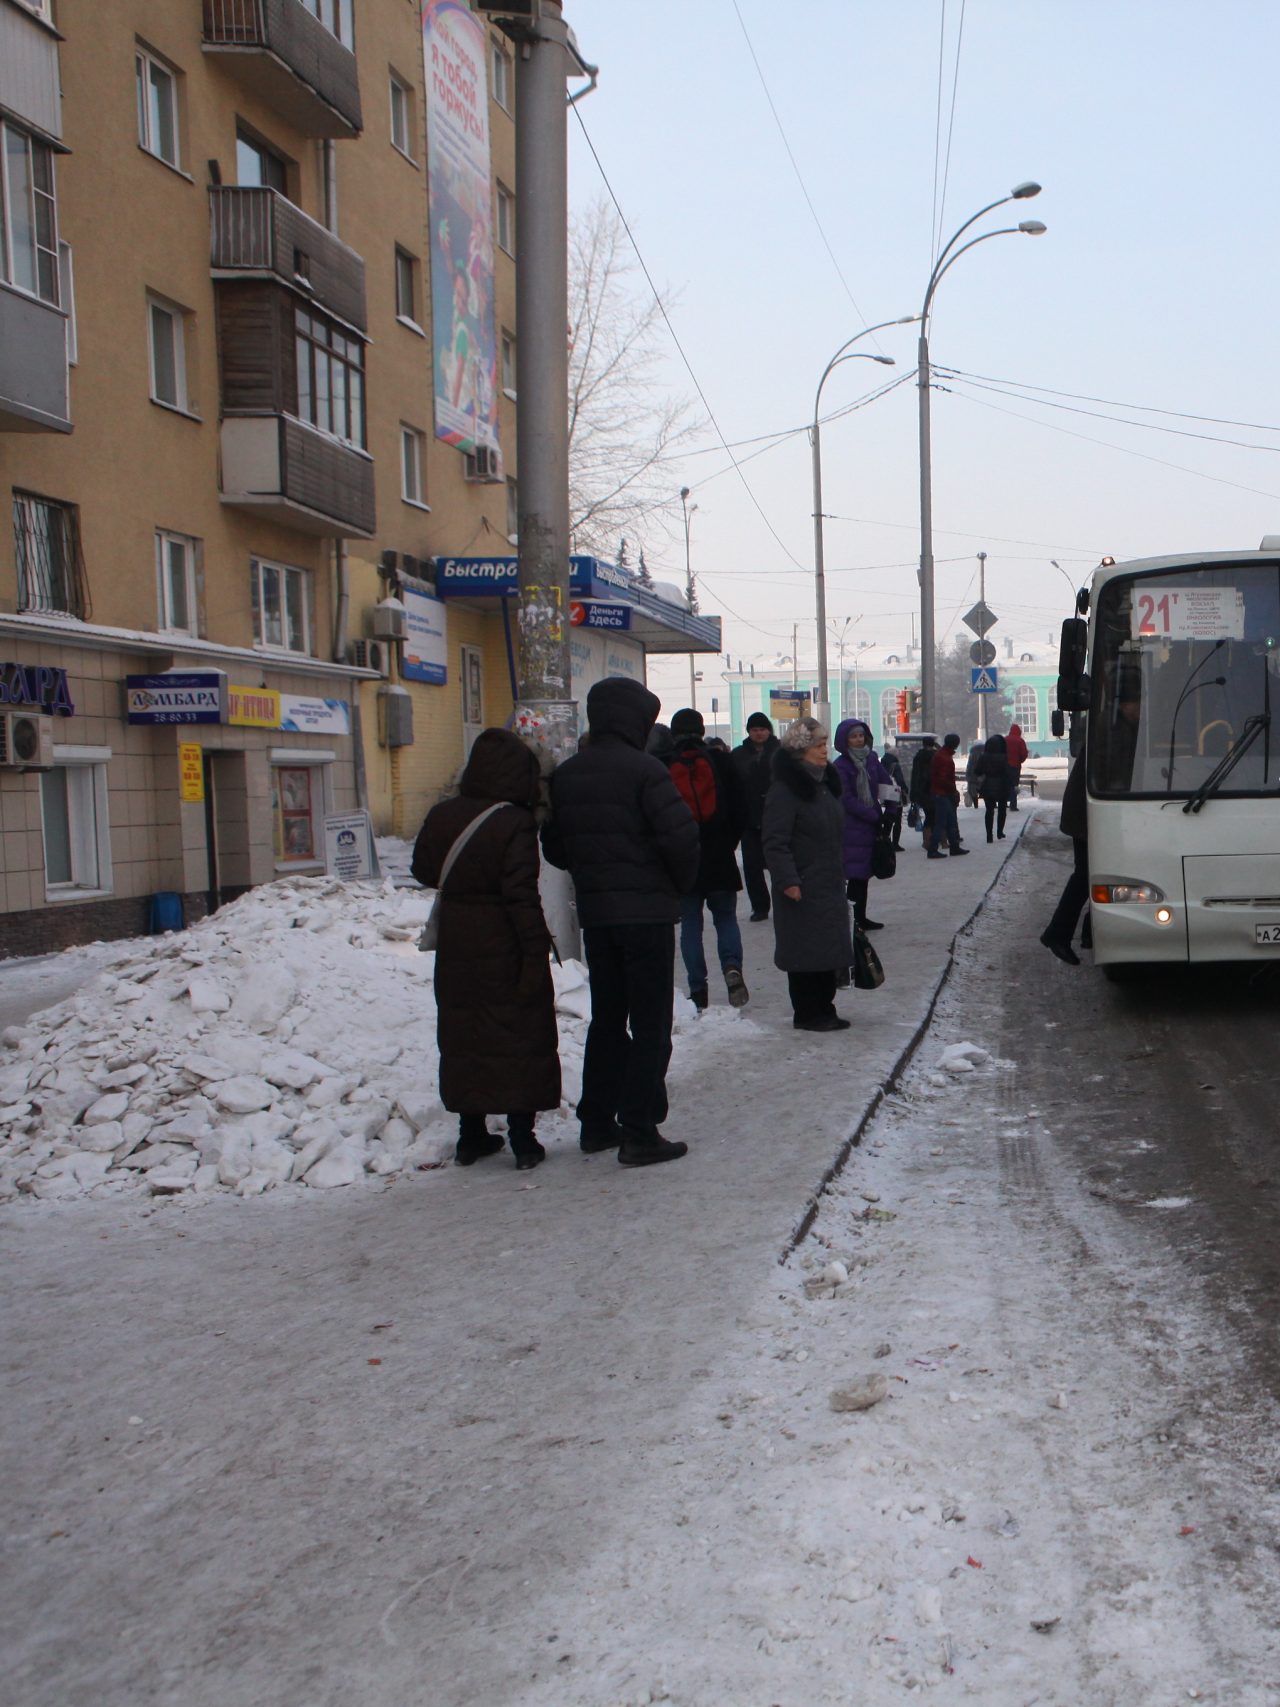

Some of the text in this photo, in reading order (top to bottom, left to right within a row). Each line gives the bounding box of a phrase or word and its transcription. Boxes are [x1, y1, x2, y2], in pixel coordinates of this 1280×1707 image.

[441, 53, 477, 111] тобой
[589, 605, 624, 617] Деньги
[589, 616, 623, 627] здесь
